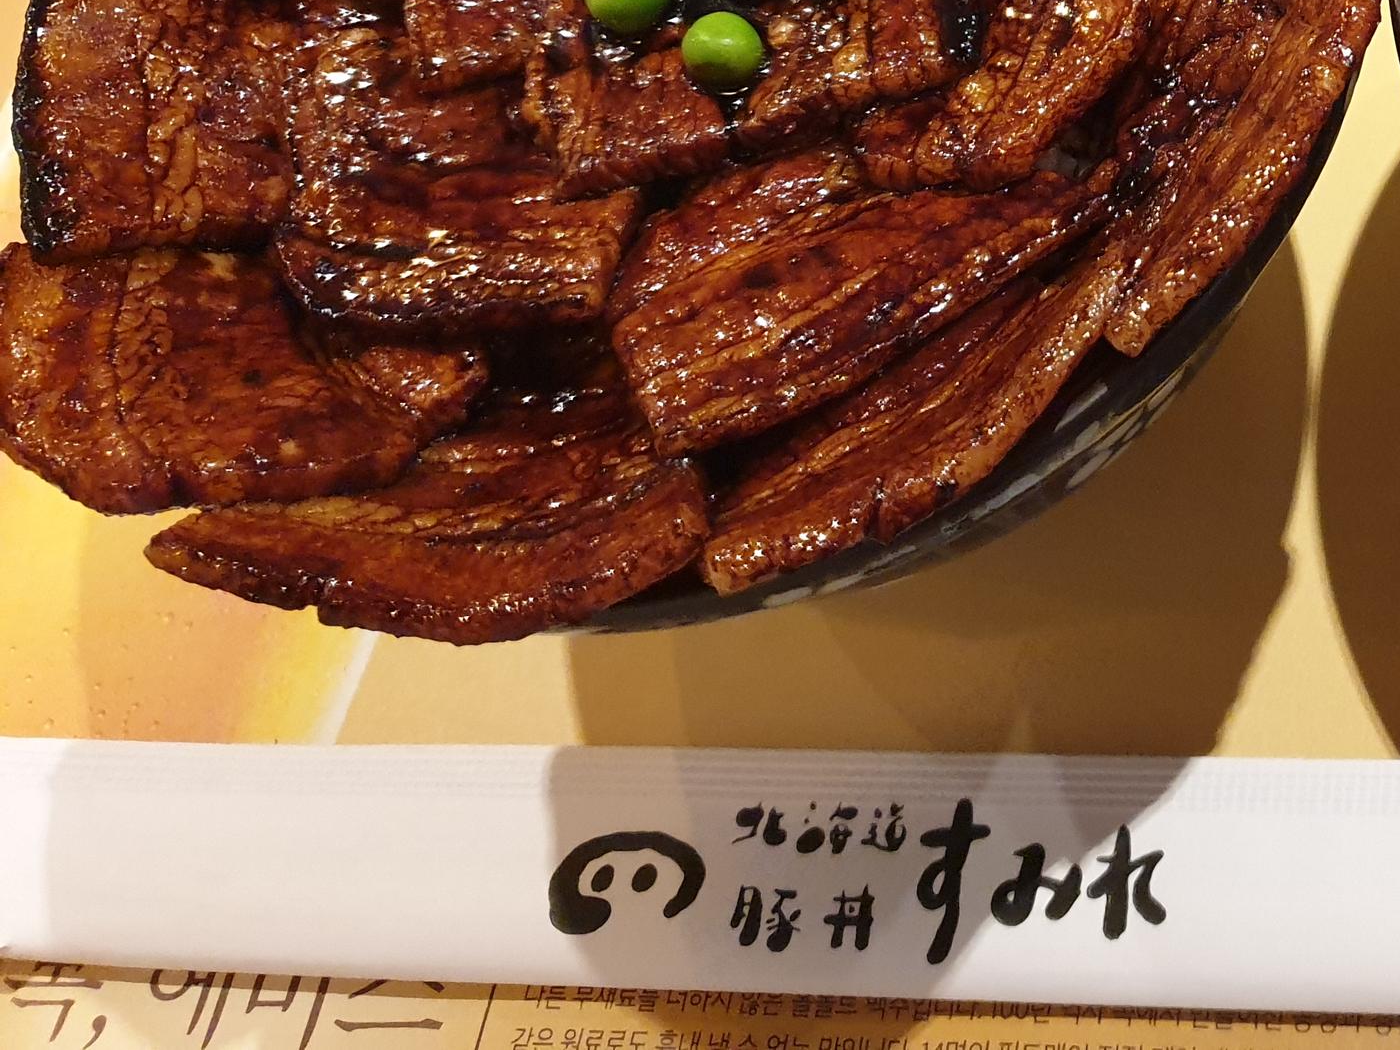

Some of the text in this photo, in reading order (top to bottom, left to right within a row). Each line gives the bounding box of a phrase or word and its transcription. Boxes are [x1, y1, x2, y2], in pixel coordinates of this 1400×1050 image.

[730, 801, 907, 854] 北海道
[916, 797, 1167, 965] すみれ
[729, 884, 877, 953] 豚丼
